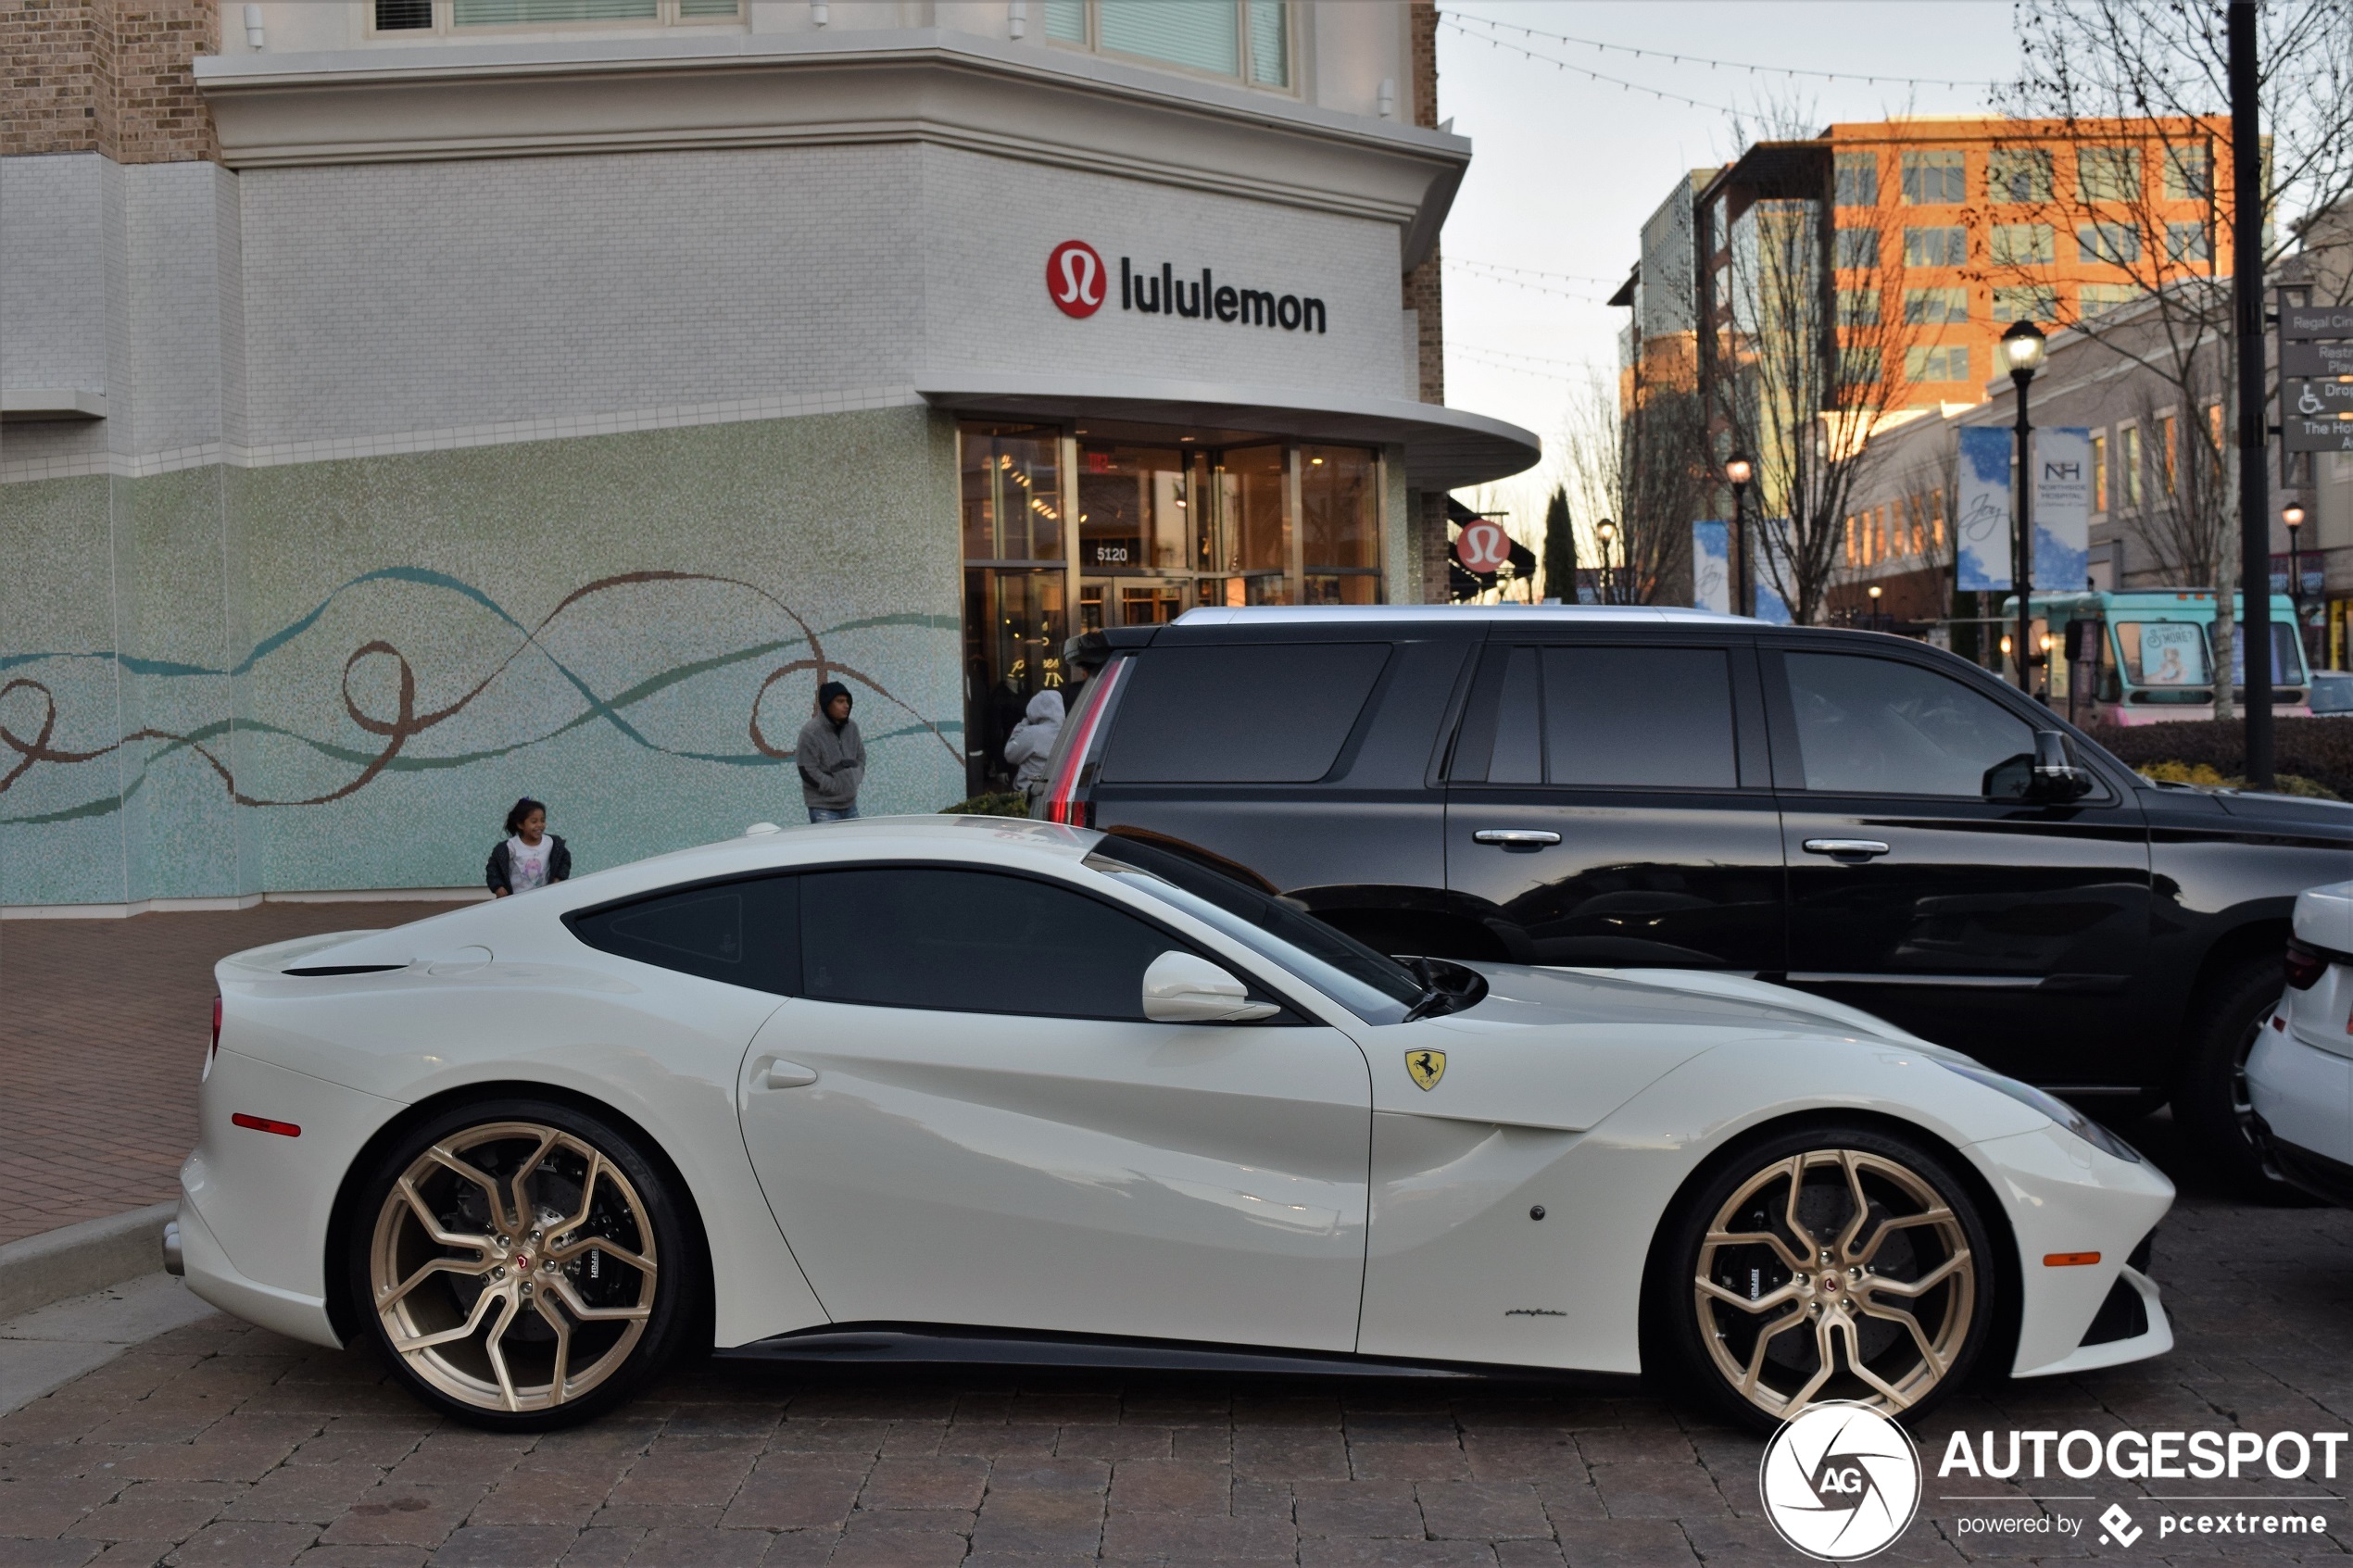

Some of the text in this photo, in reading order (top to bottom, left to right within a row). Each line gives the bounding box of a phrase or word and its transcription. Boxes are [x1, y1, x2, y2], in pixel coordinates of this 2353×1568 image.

[1121, 257, 1327, 334] lululemon
[2294, 316, 2329, 331] Regal
[2303, 421, 2330, 435] The
[1097, 547, 1127, 561] 5120
